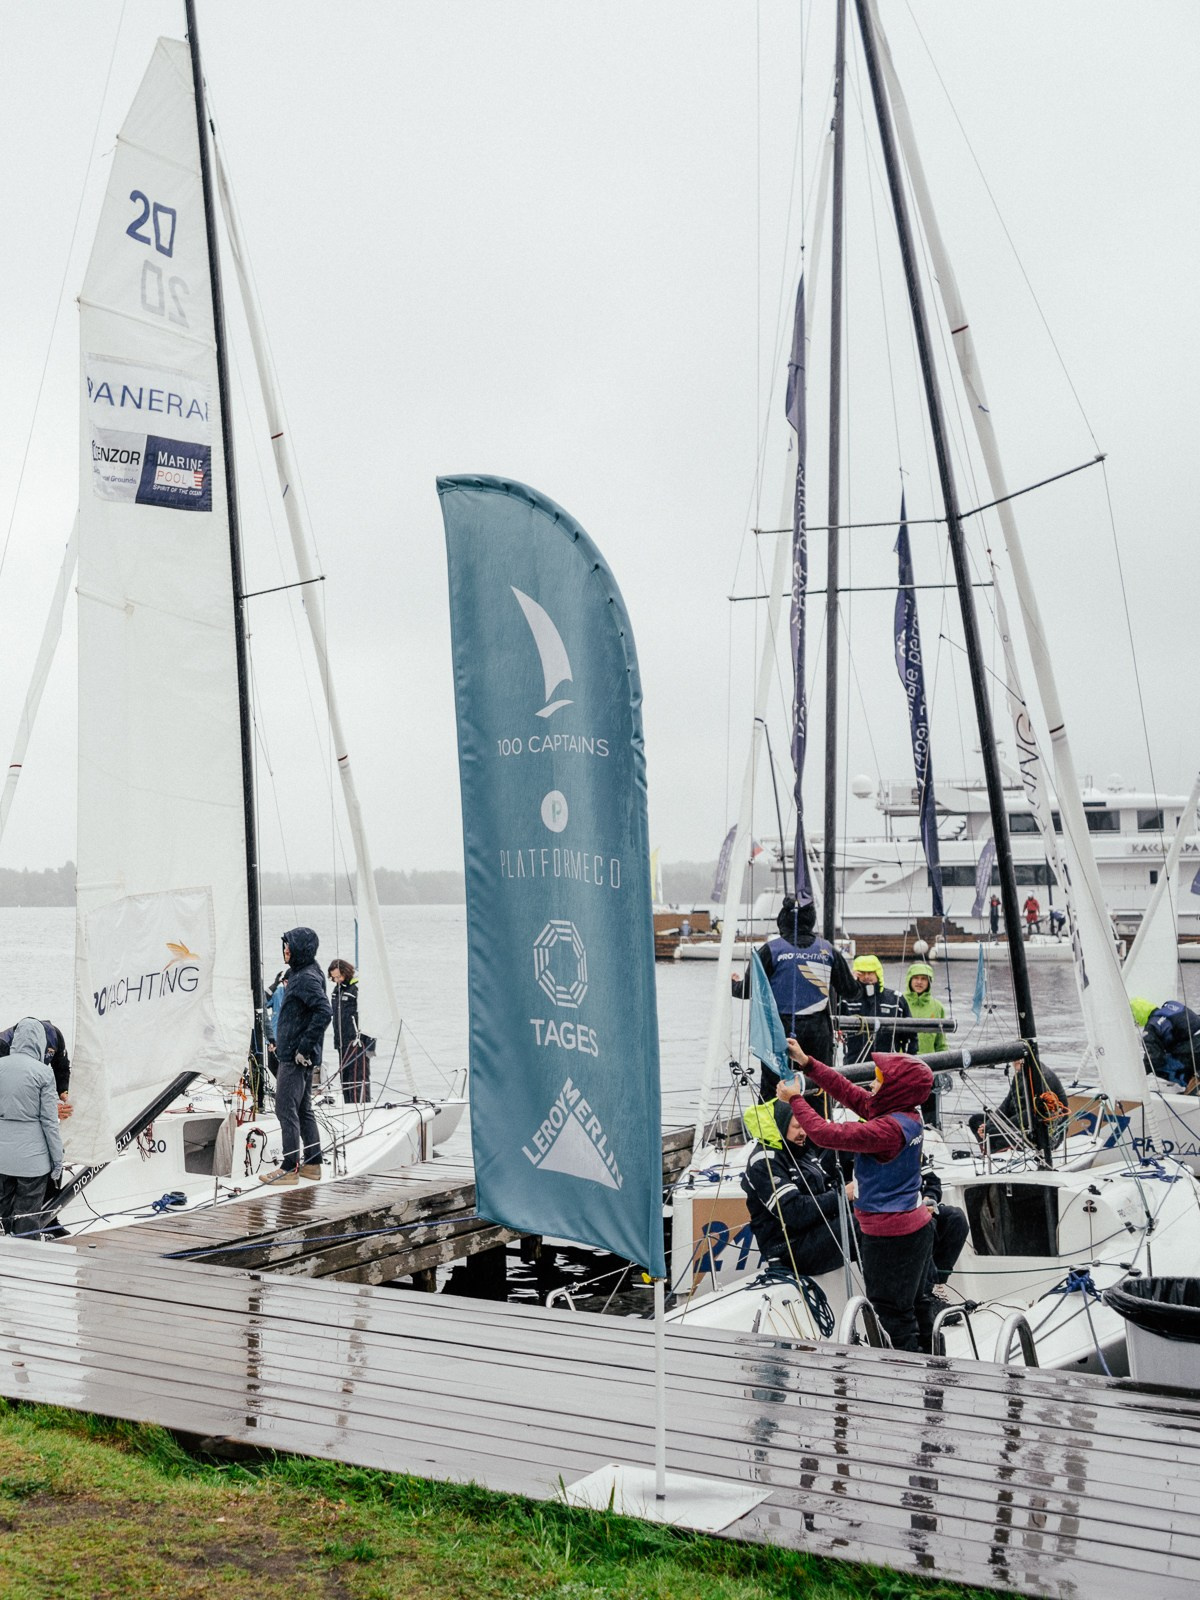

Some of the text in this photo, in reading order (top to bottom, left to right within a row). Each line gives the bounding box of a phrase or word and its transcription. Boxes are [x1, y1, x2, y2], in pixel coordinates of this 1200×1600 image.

[125, 190, 177, 258] 20
[157, 451, 203, 472] MARINE
[156, 470, 188, 485] POOL
[497, 734, 610, 757] 100 CAPTAINS
[530, 1018, 599, 1058] TAGES
[149, 1139, 167, 1154] 20
[521, 1076, 624, 1188] LEROY MERLIN
[693, 1221, 754, 1274] 21
